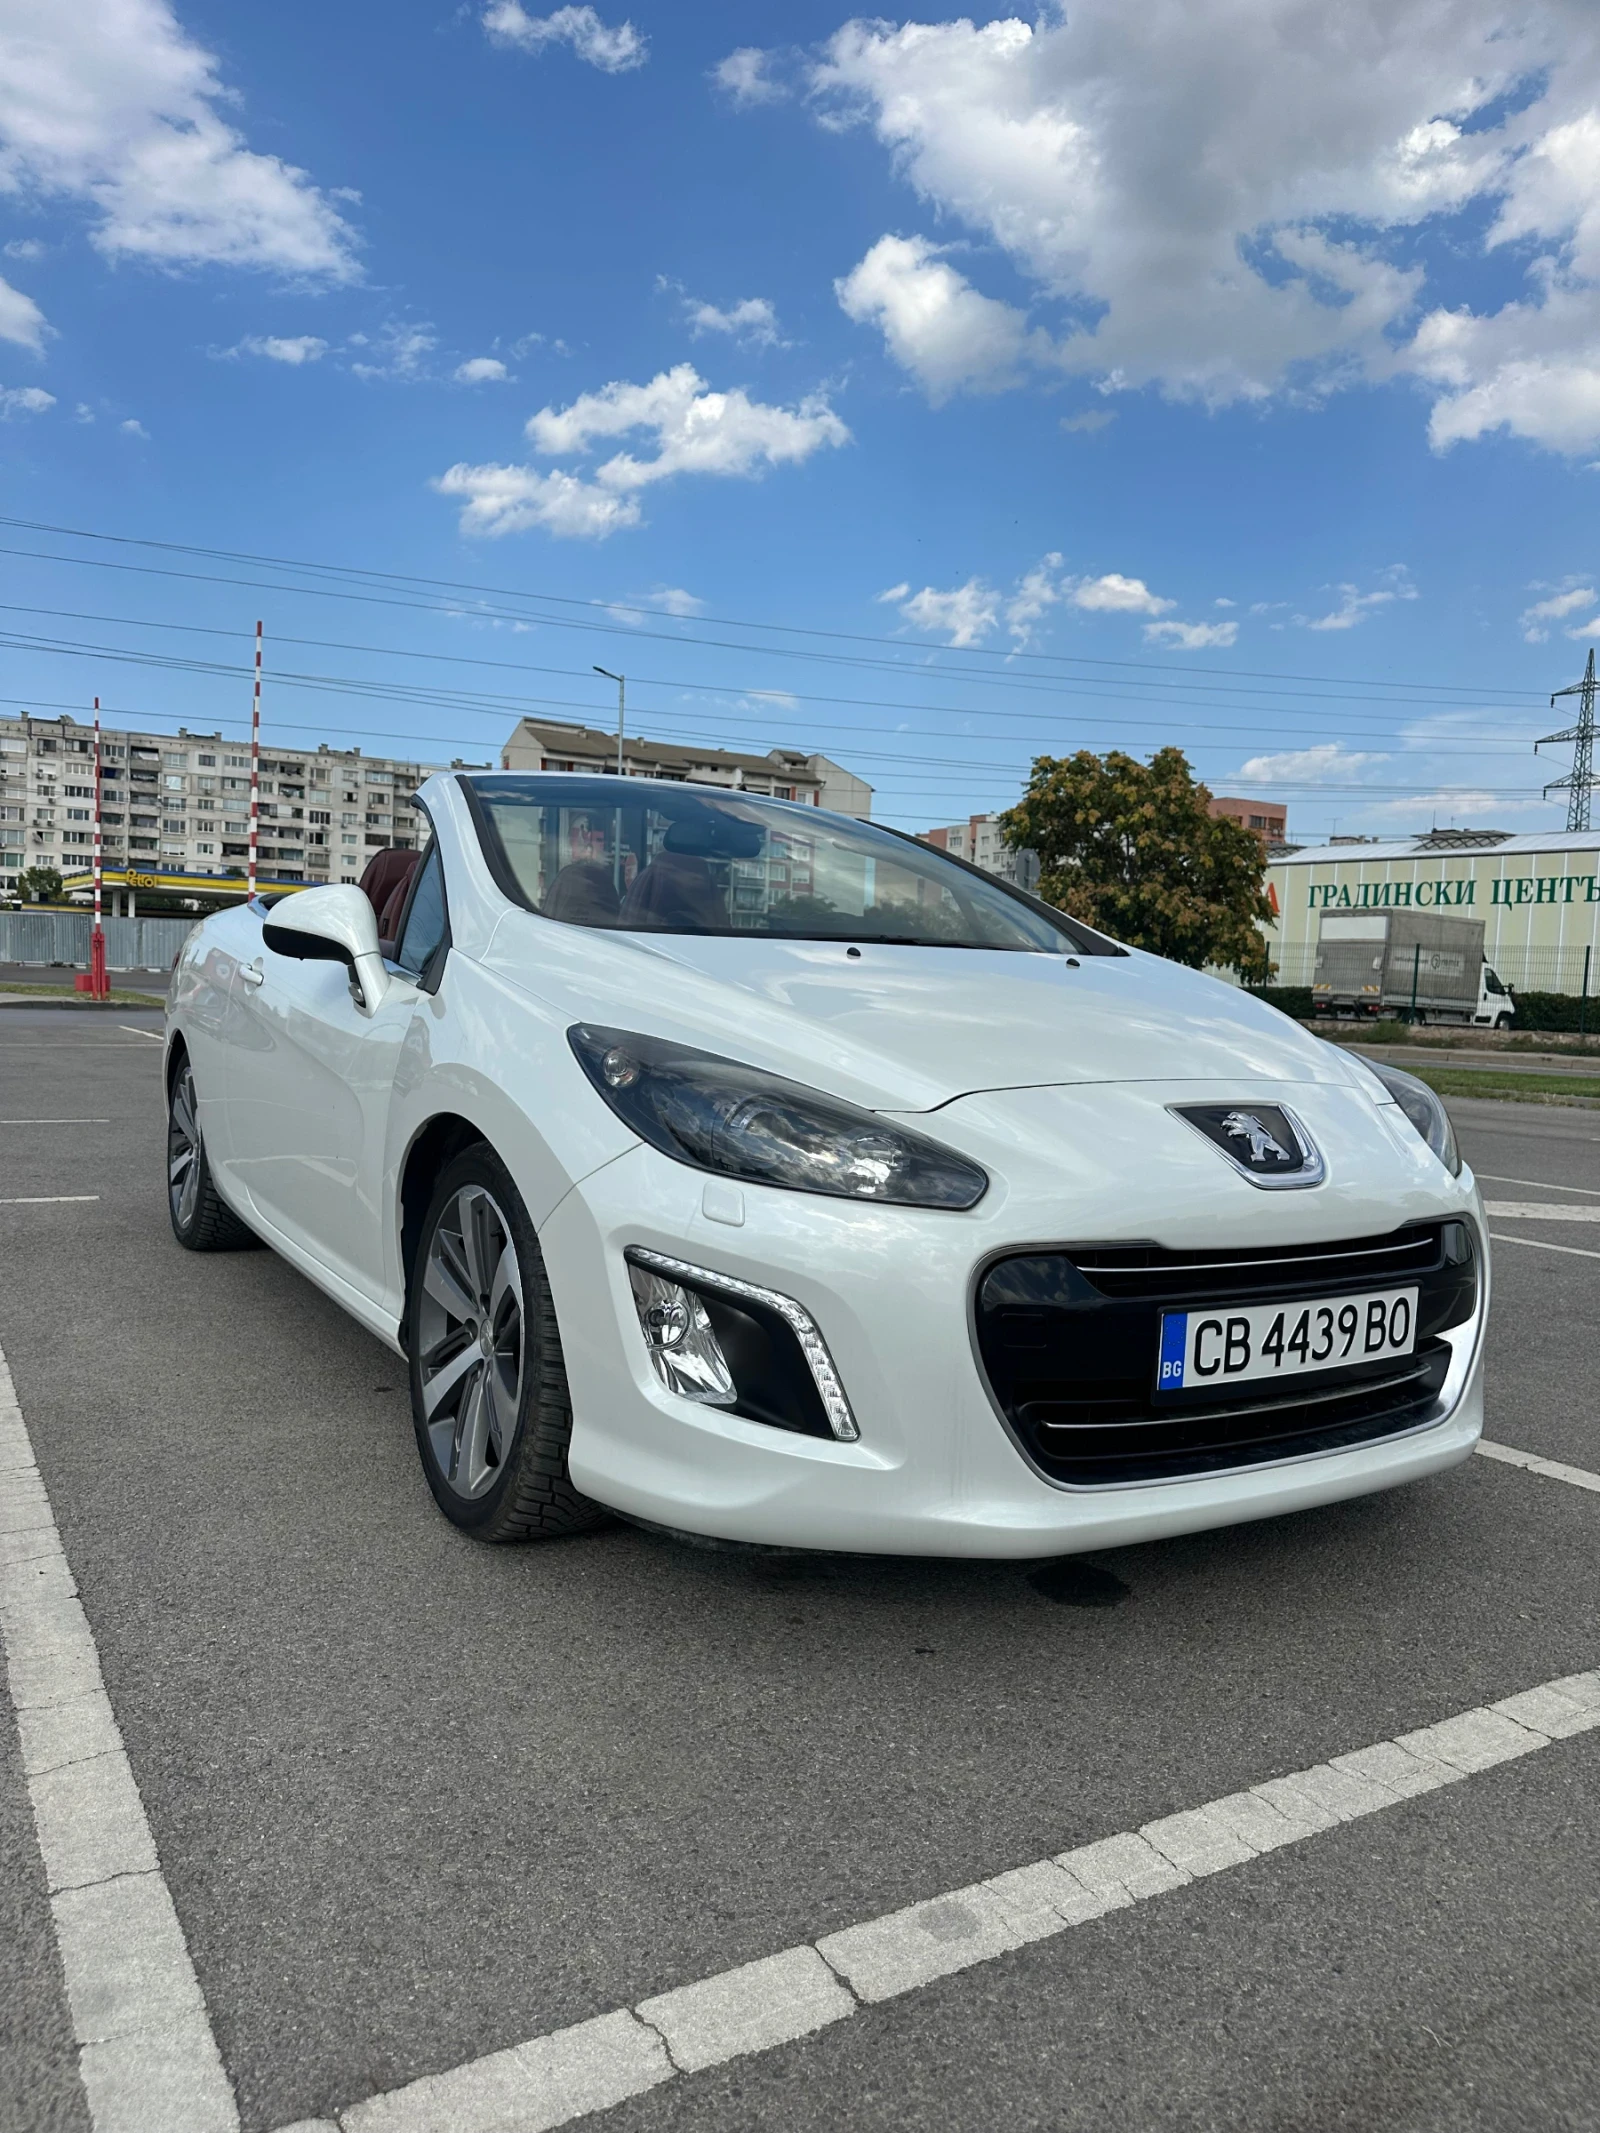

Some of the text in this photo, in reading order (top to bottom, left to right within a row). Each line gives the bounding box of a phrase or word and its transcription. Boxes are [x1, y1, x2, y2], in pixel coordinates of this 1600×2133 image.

[126, 868, 157, 888] Petrol
[1307, 880, 1477, 909] ГРАДИНСКИ
[1193, 1316, 1251, 1376] CB
[1261, 1304, 1358, 1367] 4439
[1162, 1360, 1183, 1379] BG
